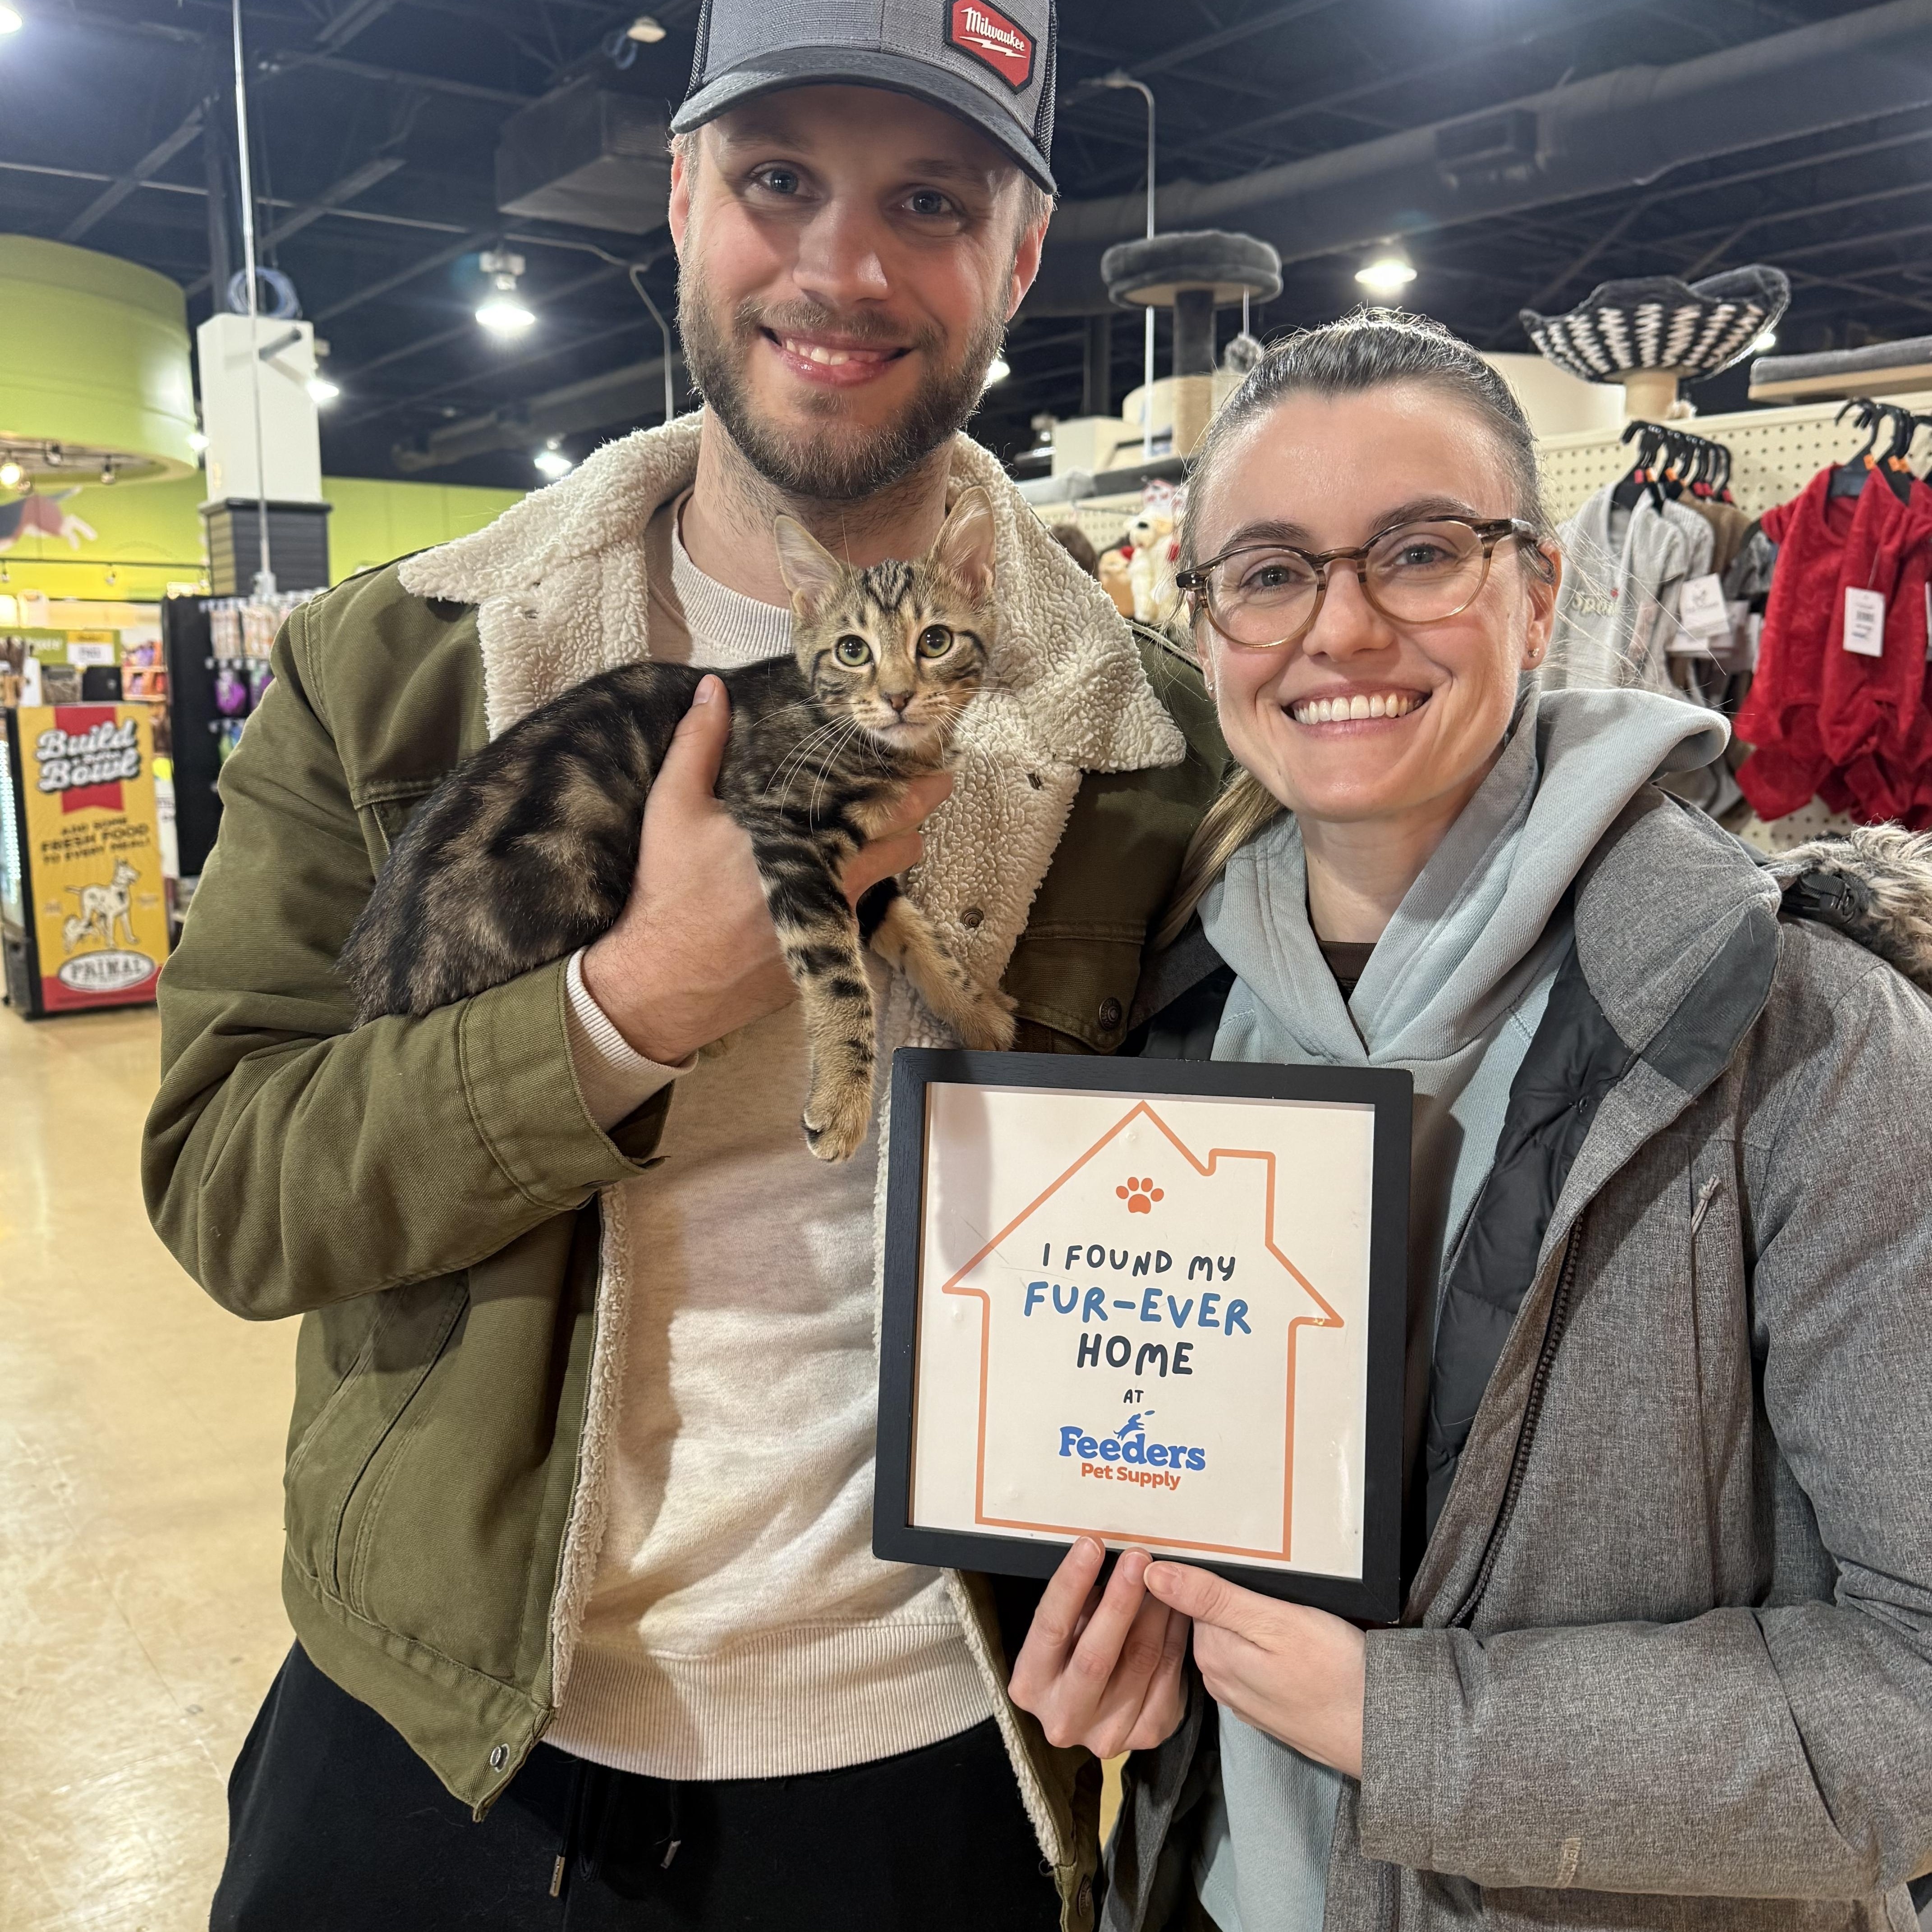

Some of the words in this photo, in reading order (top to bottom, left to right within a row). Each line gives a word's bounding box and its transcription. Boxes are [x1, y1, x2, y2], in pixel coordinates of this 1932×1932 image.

[961, 7, 1025, 51] Milwaukee
[36, 719, 136, 759] Build
[38, 747, 138, 791] Bowl
[101, 823, 149, 840] FOOD
[70, 959, 142, 980] PRIMAL
[1043, 1243, 1050, 1266] I
[1065, 1244, 1172, 1277] FOUND
[1024, 1281, 1251, 1336] FUR-EVER
[1077, 1333, 1194, 1377] HOME
[1123, 1389, 1144, 1404] AT
[1059, 1426, 1205, 1471] Feeders
[1081, 1463, 1113, 1480] Pet
[1117, 1467, 1181, 1490] Supply
